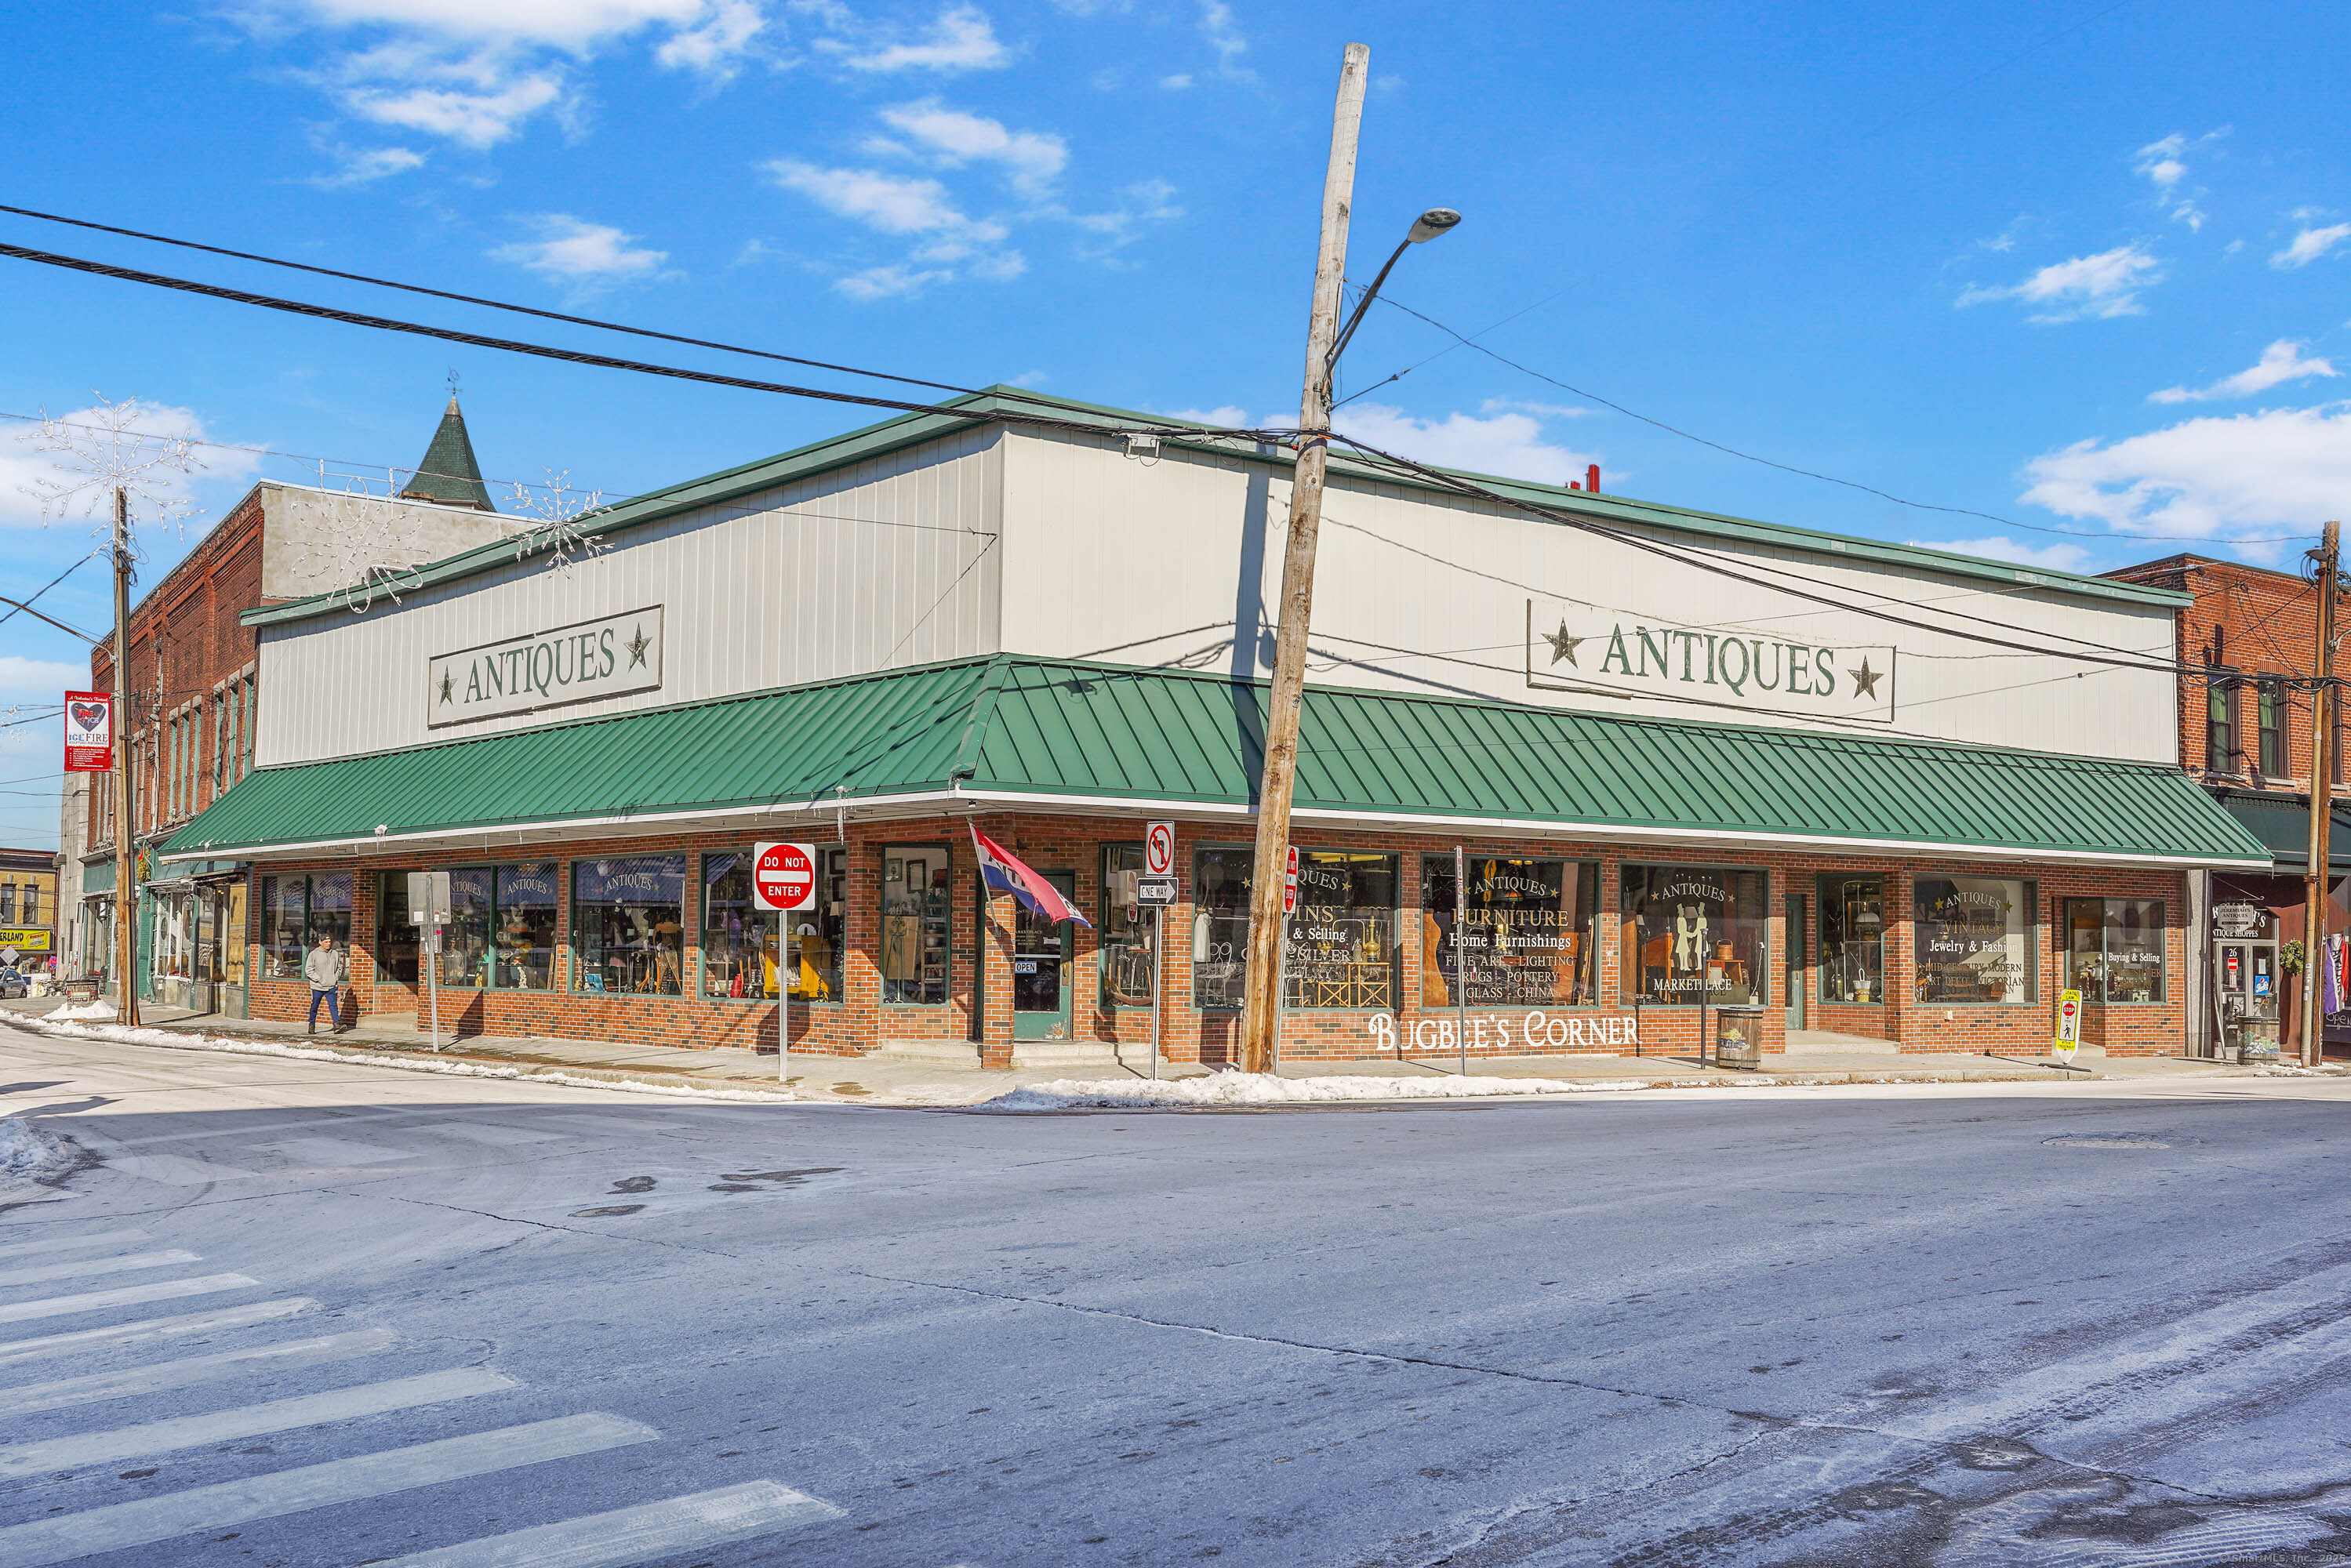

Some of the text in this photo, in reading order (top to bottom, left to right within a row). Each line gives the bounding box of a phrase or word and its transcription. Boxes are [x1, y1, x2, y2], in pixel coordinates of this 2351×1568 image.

[464, 627, 615, 704] ANTIQUES
[1600, 622, 1834, 697] ANTIQUES
[85, 733, 108, 742] FIRE
[764, 857, 805, 868] DO NOT
[508, 878, 547, 895] ANTIQUES
[606, 873, 652, 891] ANTIQUES
[1297, 869, 1339, 891] QUES
[1474, 876, 1546, 896] ANTIQUES
[451, 880, 482, 897] NTIQUES
[768, 886, 801, 897] ENTER
[1141, 887, 1168, 897] ONE WAY
[1662, 883, 1726, 902] ANTIQUES
[1946, 891, 2001, 910] ANTIQUES
[1288, 905, 1334, 923] INS
[1293, 927, 1346, 942] & Selling
[1945, 920, 2004, 935] VINTAGE
[2212, 928, 2233, 938] NTIQUE
[1449, 932, 1571, 951] Home Furnishings
[1930, 939, 2019, 954] Jewelry & Fashion
[1298, 949, 1351, 961] SILVER
[2108, 953, 2160, 964] Buying & Selling
[2229, 947, 2237, 957] 26
[1445, 955, 1474, 967] FINE
[1481, 956, 1504, 967] ART
[1518, 956, 1575, 967] LIGHTING
[1987, 963, 2022, 972] MODERN
[1463, 971, 1492, 982] RUGS
[1506, 971, 1559, 982] POTTERY
[1466, 987, 1503, 998] GLASS
[1517, 987, 1555, 998] CHINA
[1368, 1011, 1643, 1051] BUGBEE'S CORNER
